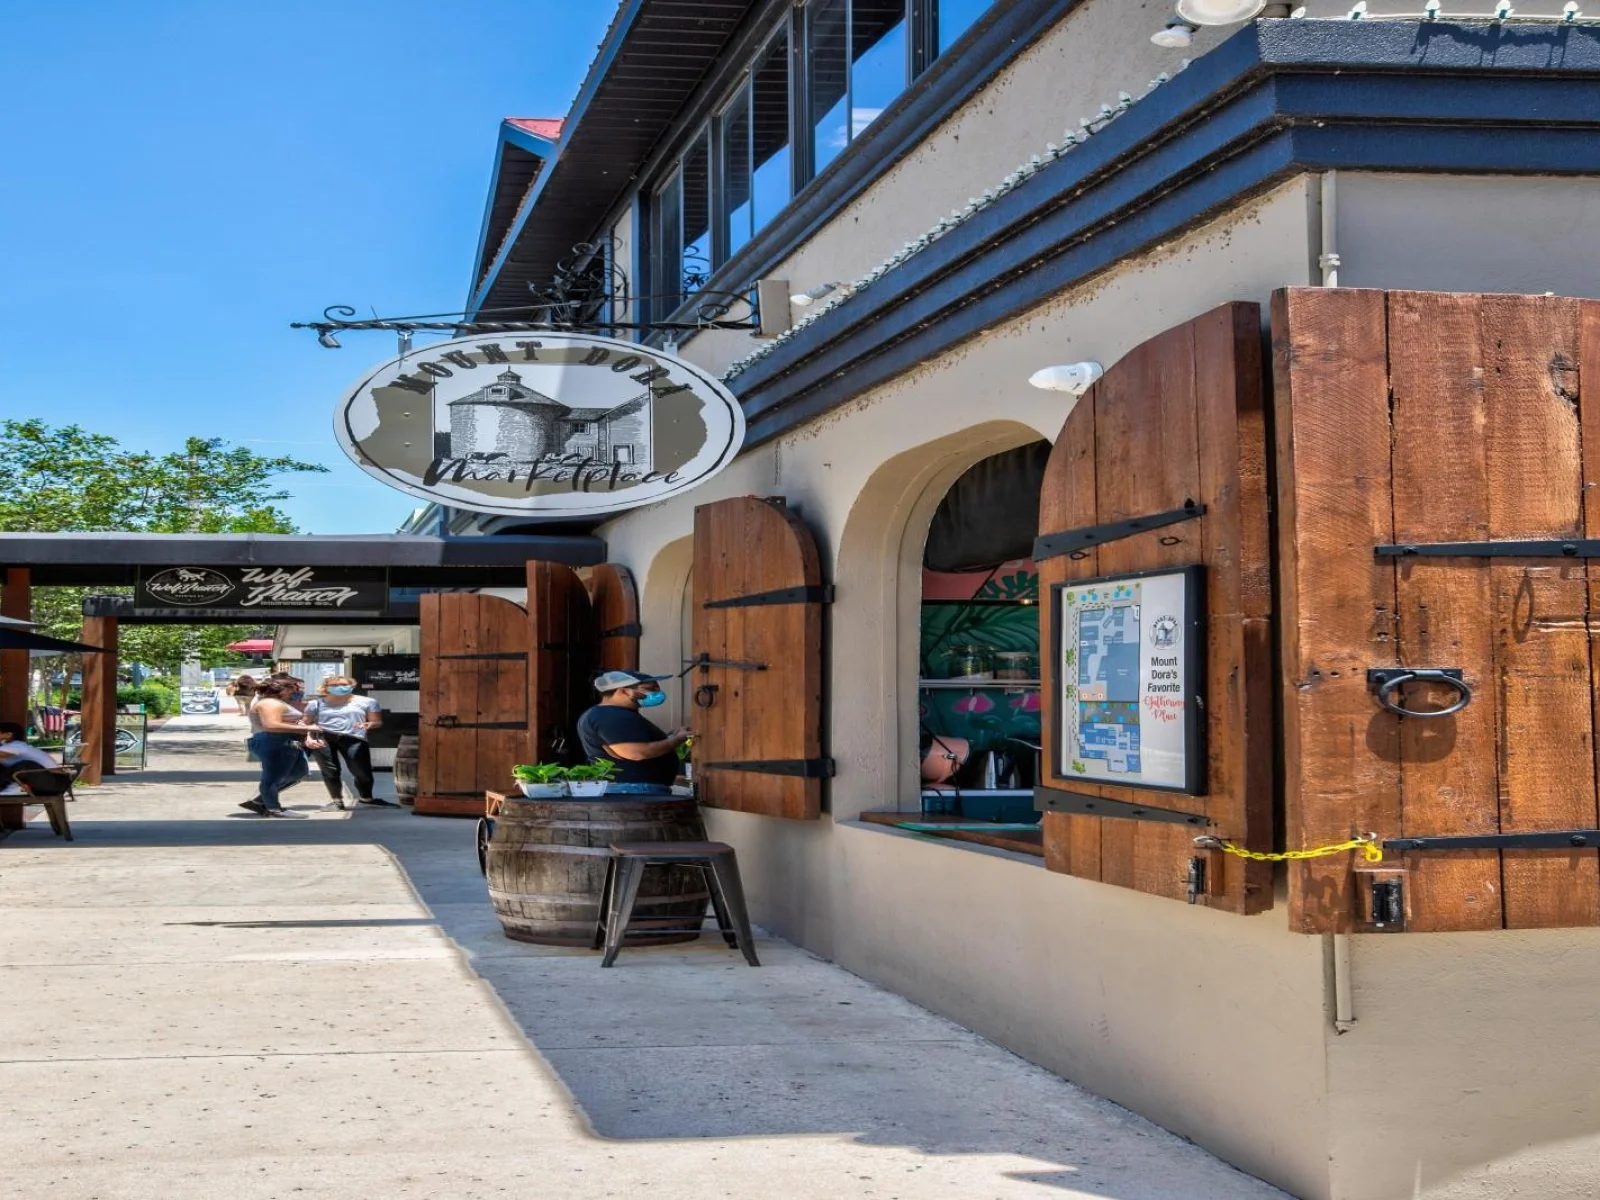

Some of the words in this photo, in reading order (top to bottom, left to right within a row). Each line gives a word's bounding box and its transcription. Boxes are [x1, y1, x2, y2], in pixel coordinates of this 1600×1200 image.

[388, 340, 543, 396] MOUNT
[583, 345, 694, 398] DORA
[422, 456, 685, 493] Marketplace
[240, 566, 315, 589] Wolf
[239, 583, 359, 607] Branch
[1151, 656, 1178, 667] Mount
[1151, 669, 1178, 680] Dora's
[1147, 682, 1181, 693] Favorite
